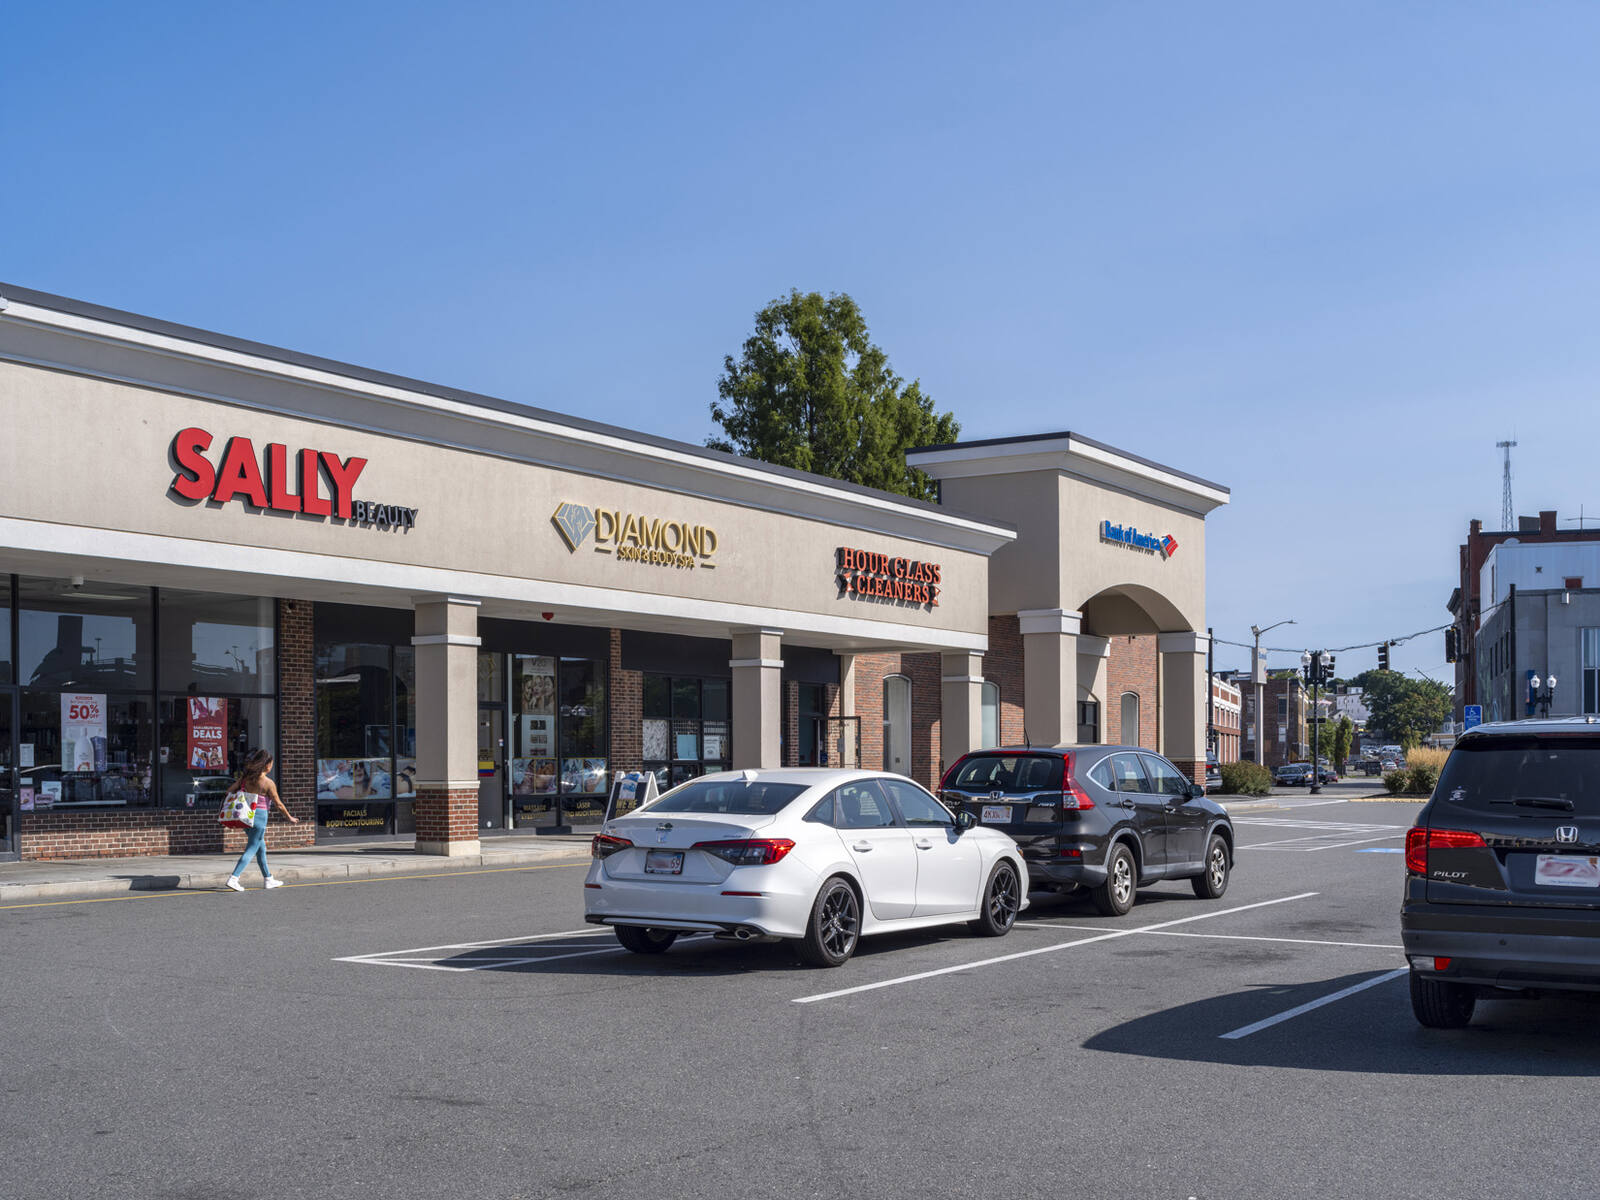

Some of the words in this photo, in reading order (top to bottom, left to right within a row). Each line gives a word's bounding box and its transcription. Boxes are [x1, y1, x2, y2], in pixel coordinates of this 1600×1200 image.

[171, 427, 368, 519] SALLY
[355, 501, 418, 528] BEAUTY
[595, 508, 718, 555] DIAMOND
[1104, 520, 1125, 542] Bank
[1124, 527, 1132, 544] of
[1132, 528, 1161, 551] America
[618, 545, 641, 560] SKIN
[643, 550, 650, 561] &
[652, 551, 678, 565] BODY
[677, 554, 696, 568] SPA
[842, 547, 890, 575] HOUR
[894, 557, 941, 584] GLASS
[856, 575, 930, 603] CLEANERS
[69, 704, 99, 720] 50%
[193, 729, 222, 739] DEALS
[343, 809, 367, 817] FACIALS
[344, 818, 384, 827] CONTOURING
